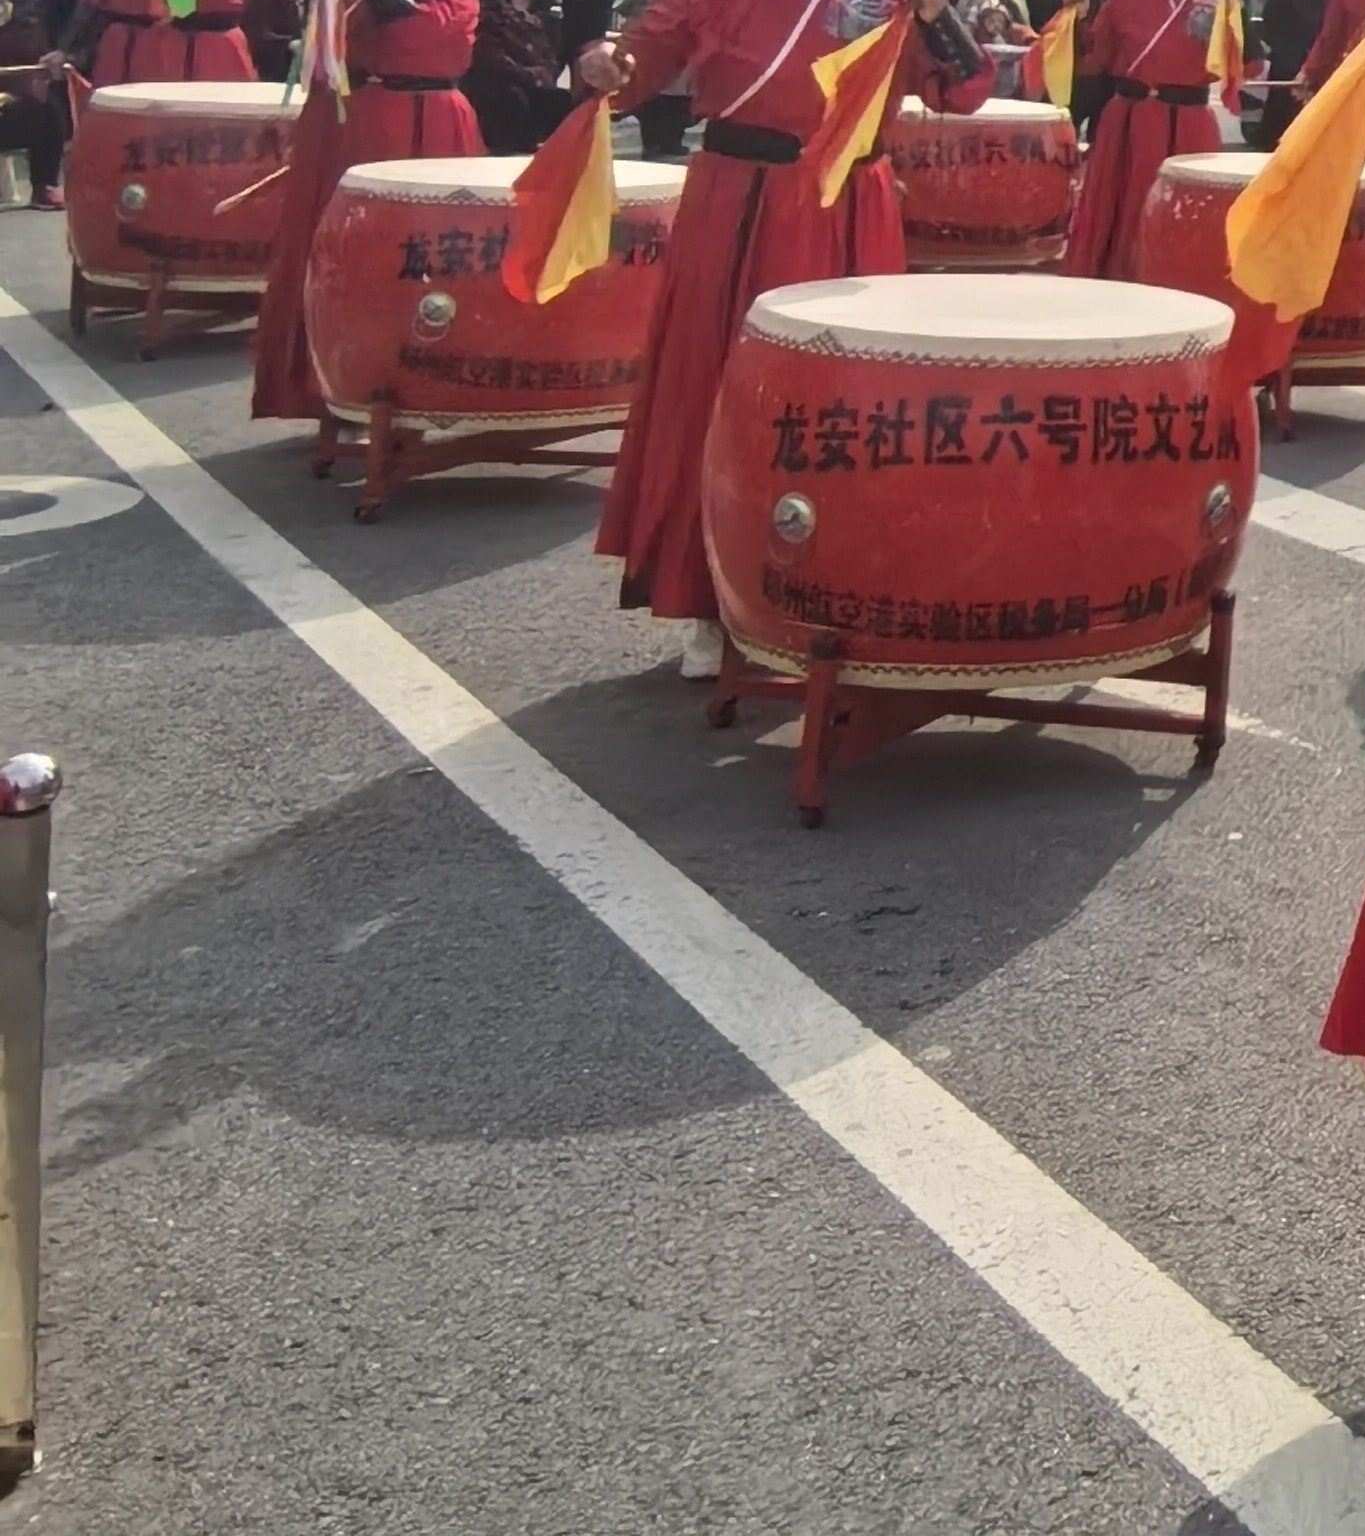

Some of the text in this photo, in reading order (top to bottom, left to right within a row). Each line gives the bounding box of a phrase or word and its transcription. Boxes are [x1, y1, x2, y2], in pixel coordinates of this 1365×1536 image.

[771, 393, 1241, 471] 龙安社区六号院文艺队
